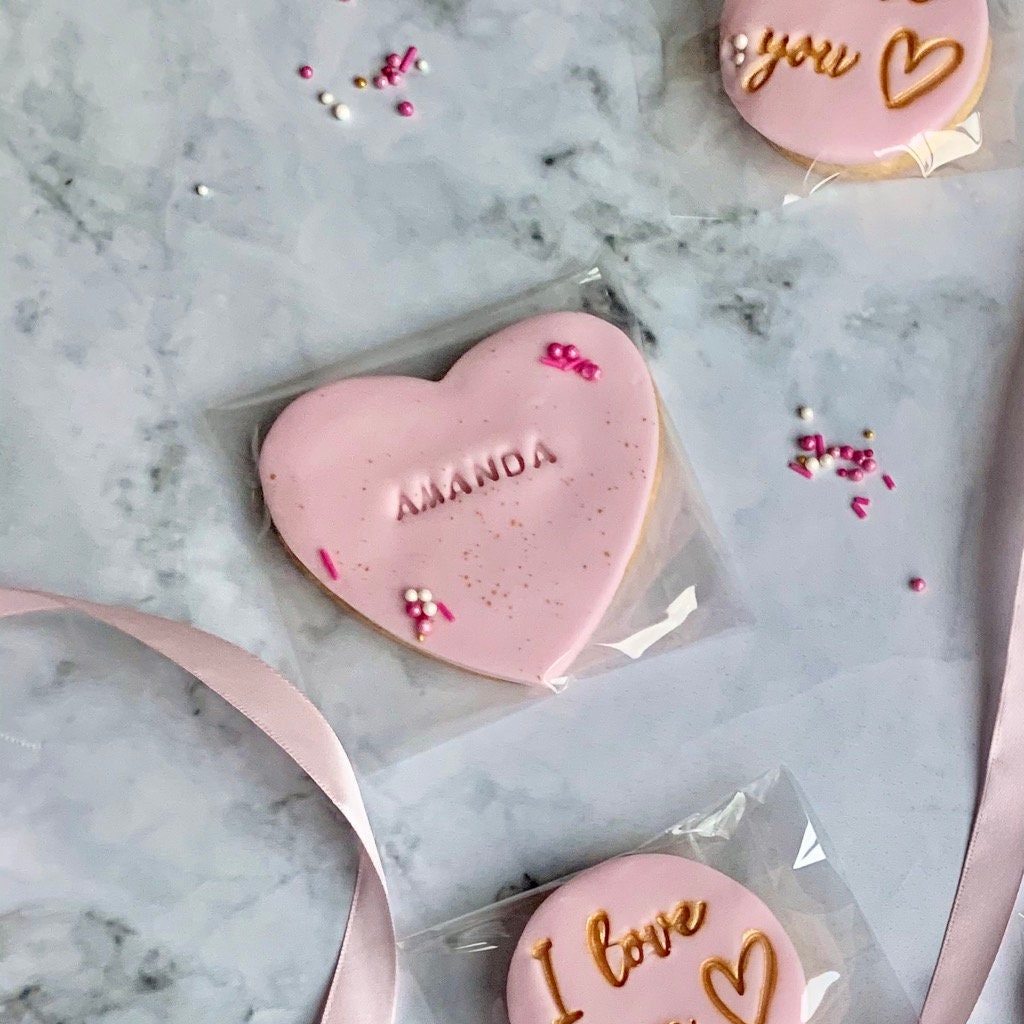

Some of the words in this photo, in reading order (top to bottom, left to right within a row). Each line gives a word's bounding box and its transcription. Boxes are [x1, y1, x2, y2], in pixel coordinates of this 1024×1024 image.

[741, 27, 861, 93] you
[396, 440, 558, 521] AMANDA
[586, 900, 707, 987] love
